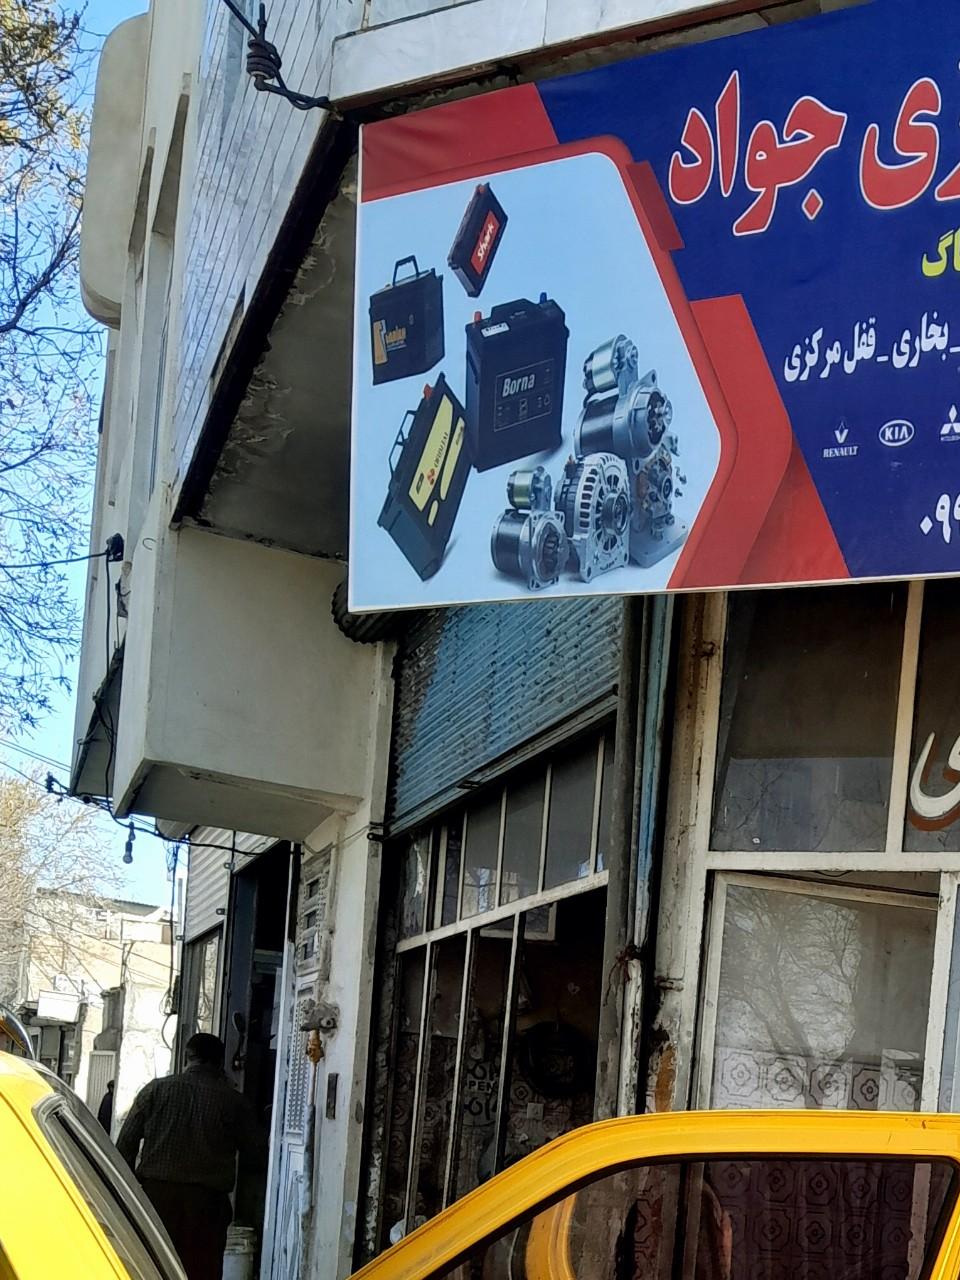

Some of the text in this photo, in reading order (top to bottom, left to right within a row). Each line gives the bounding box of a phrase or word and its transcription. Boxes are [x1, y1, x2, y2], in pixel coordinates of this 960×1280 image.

[668, 70, 848, 237] جواد
[783, 327, 842, 382] مرکزی
[843, 317, 877, 375] قفل
[892, 311, 949, 369] بخاری
[502, 374, 536, 398] Borna
[823, 445, 859, 459] RENAULT
[881, 421, 912, 444] KIA
